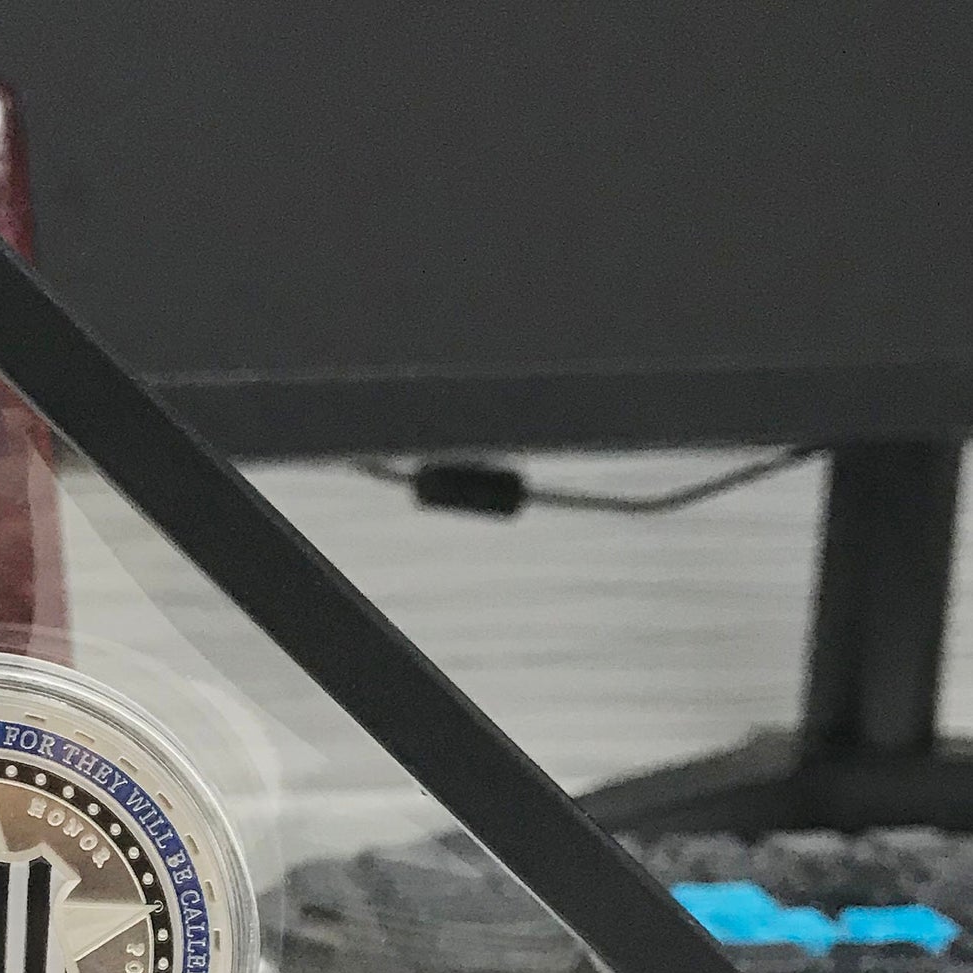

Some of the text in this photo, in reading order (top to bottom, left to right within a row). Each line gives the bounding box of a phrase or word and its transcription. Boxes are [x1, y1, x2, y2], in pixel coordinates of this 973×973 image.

[3, 725, 56, 757] FOR
[62, 744, 128, 794] THEY
[126, 786, 174, 849] WILL
[166, 849, 194, 885] BE
[27, 798, 110, 869] HONOR
